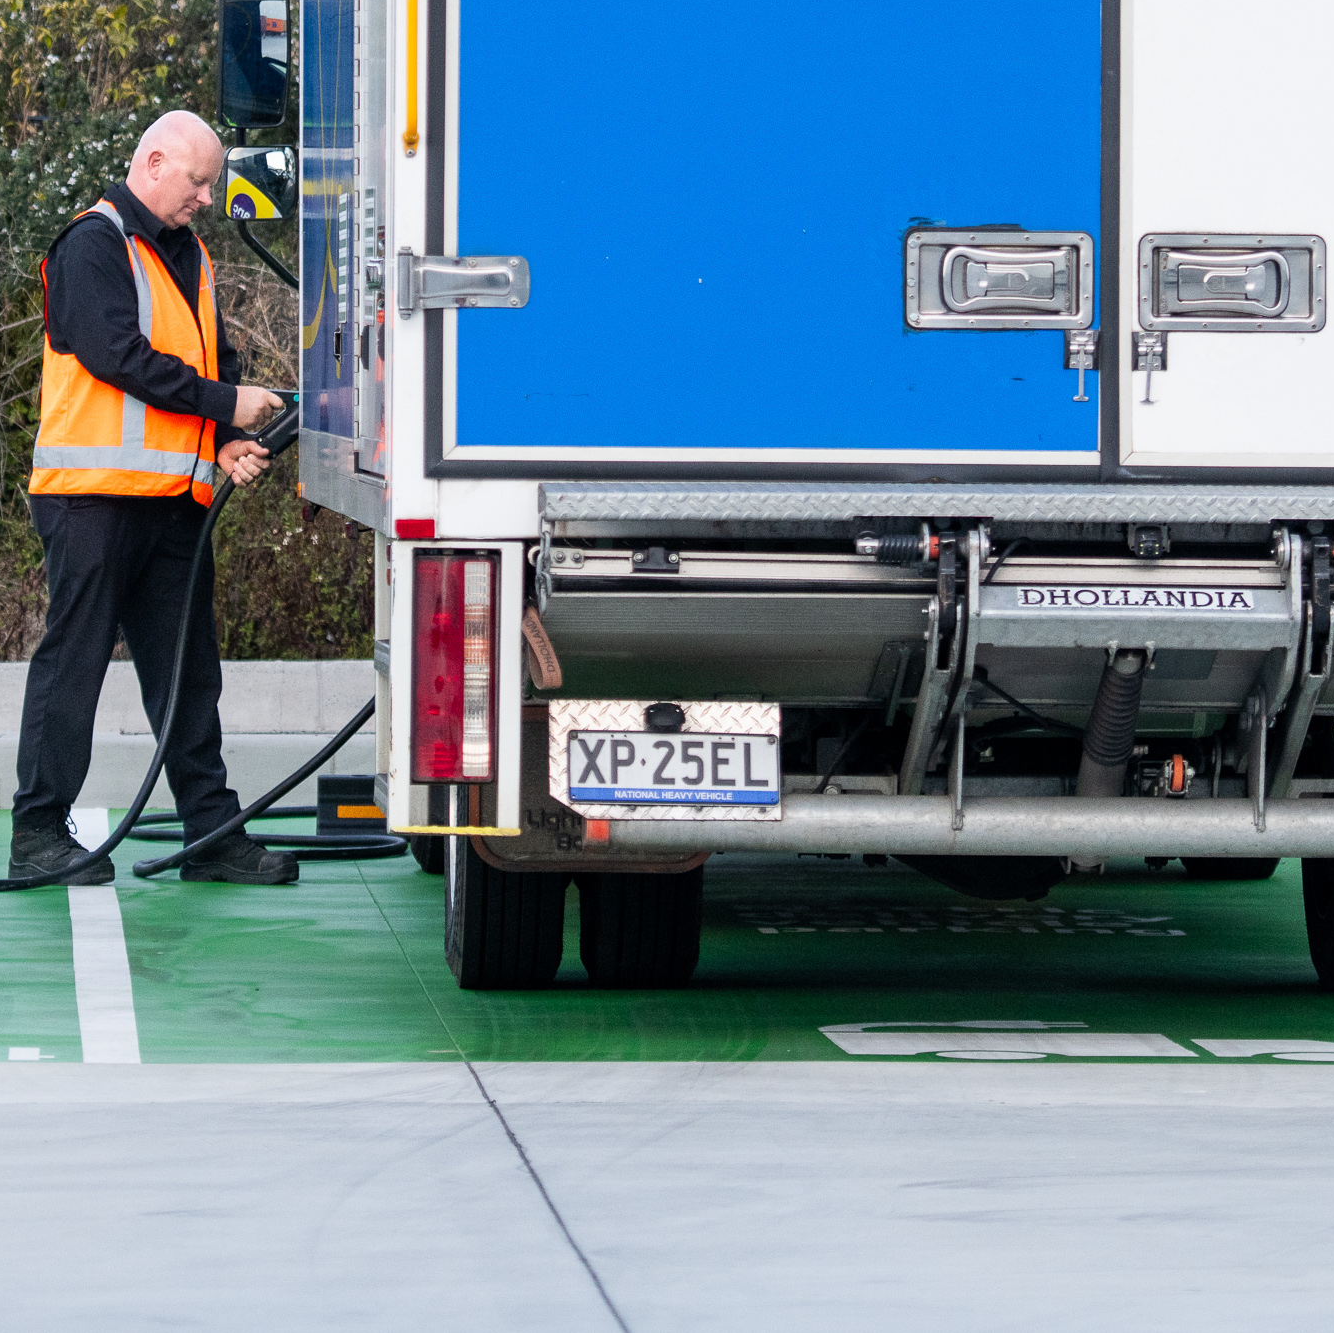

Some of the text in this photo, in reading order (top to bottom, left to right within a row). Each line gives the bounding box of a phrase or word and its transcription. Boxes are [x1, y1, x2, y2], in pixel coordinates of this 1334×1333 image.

[1020, 588, 1253, 609] DHOLLANDIA
[614, 790, 733, 801] NATIONAL HEAVY VEHICLE
